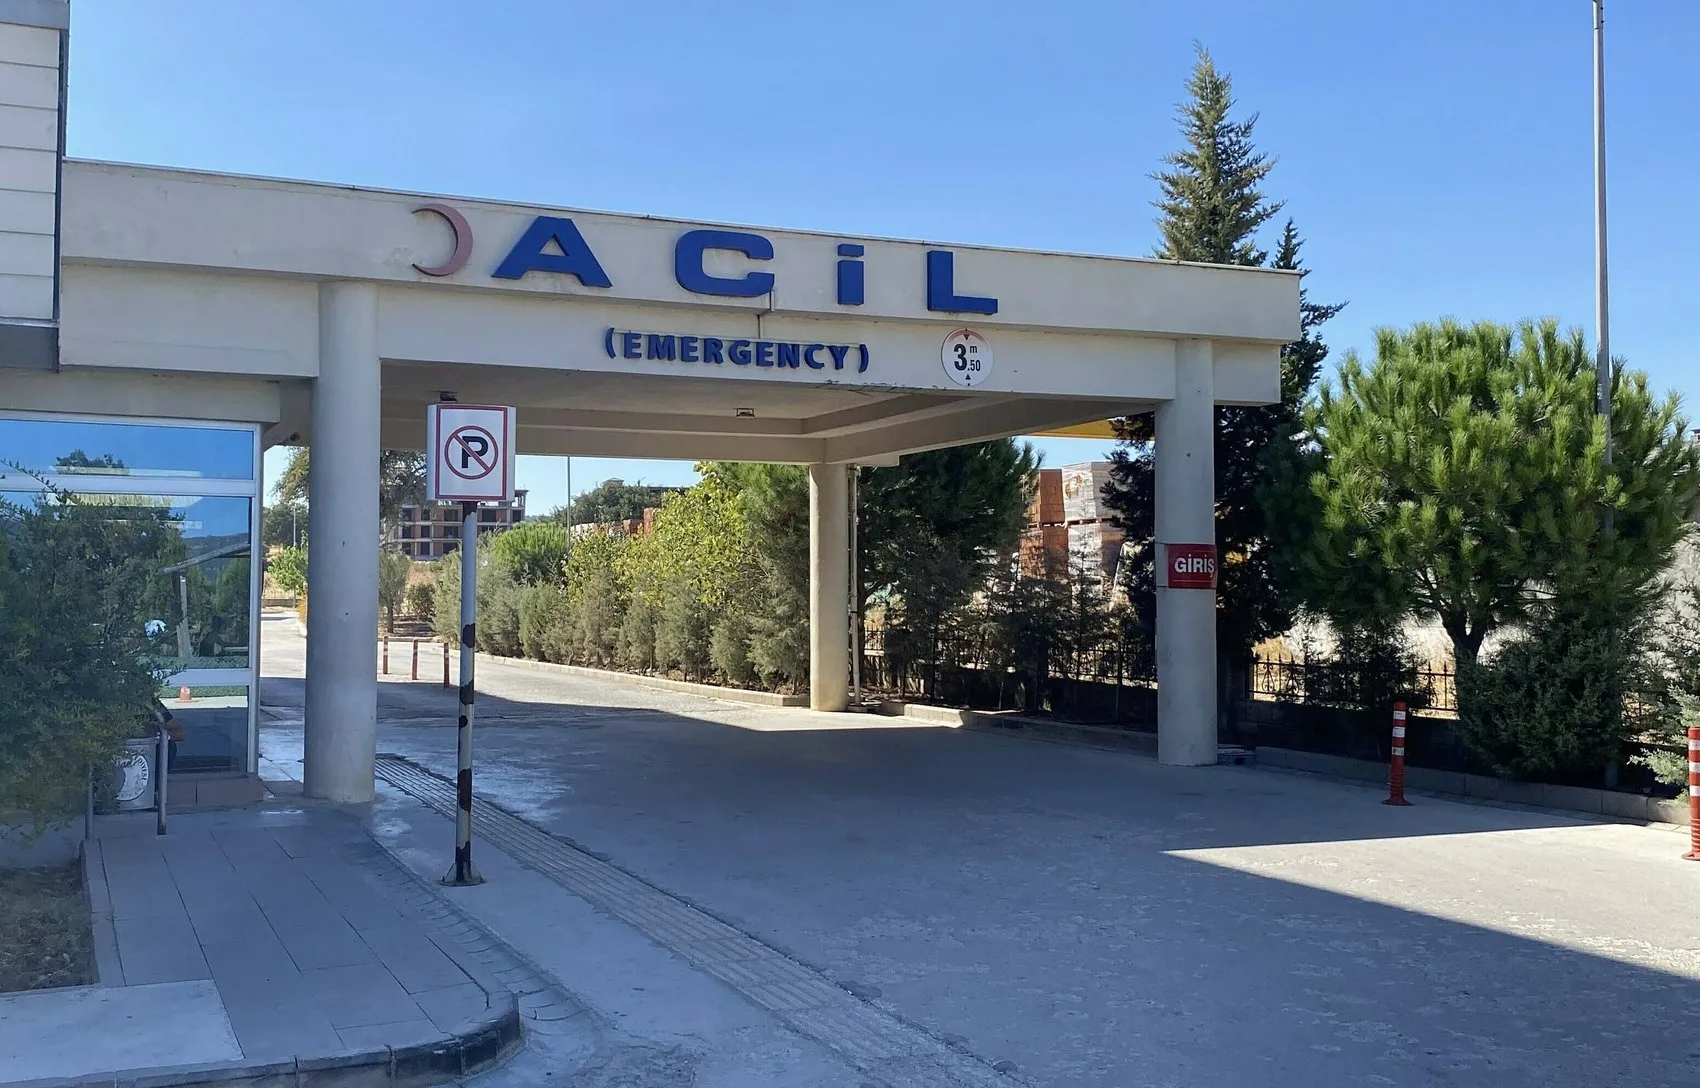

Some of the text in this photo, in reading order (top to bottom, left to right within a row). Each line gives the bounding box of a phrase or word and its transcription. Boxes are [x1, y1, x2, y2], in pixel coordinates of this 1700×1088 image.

[605, 327, 869, 373] (EMERGENCY)
[461, 435, 489, 469] P
[1174, 553, 1215, 578] GİRİŞ
